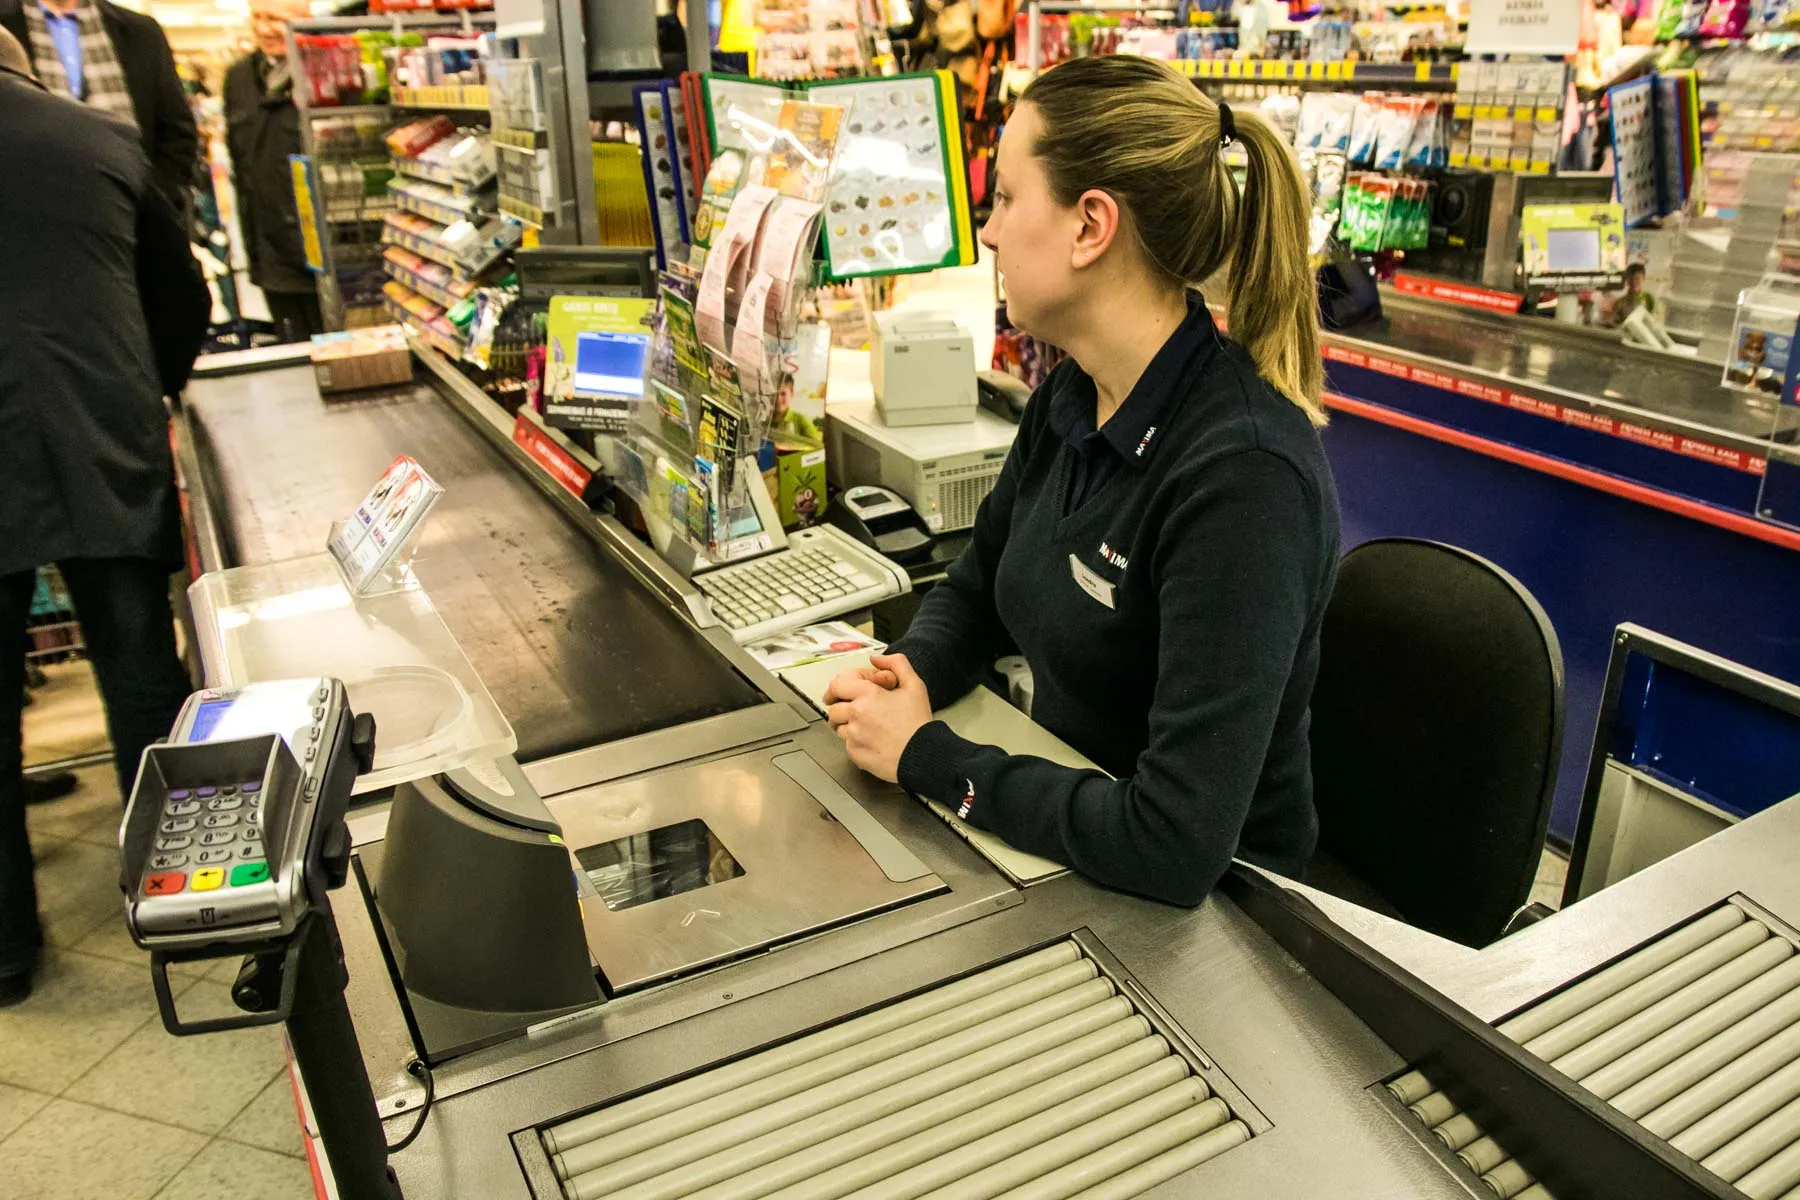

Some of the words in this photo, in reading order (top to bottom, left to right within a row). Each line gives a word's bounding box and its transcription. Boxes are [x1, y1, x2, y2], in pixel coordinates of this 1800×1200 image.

[1135, 426, 1157, 457] MAXIMA
[957, 778, 975, 819] MAXIM
[172, 804, 179, 813] 1
[212, 799, 222, 809] 2
[165, 820, 174, 830] 4
[207, 815, 218, 825] 5
[203, 833, 213, 843] 8
[246, 828, 256, 838] 9
[161, 838, 170, 849] 7
[199, 851, 209, 861] 0
